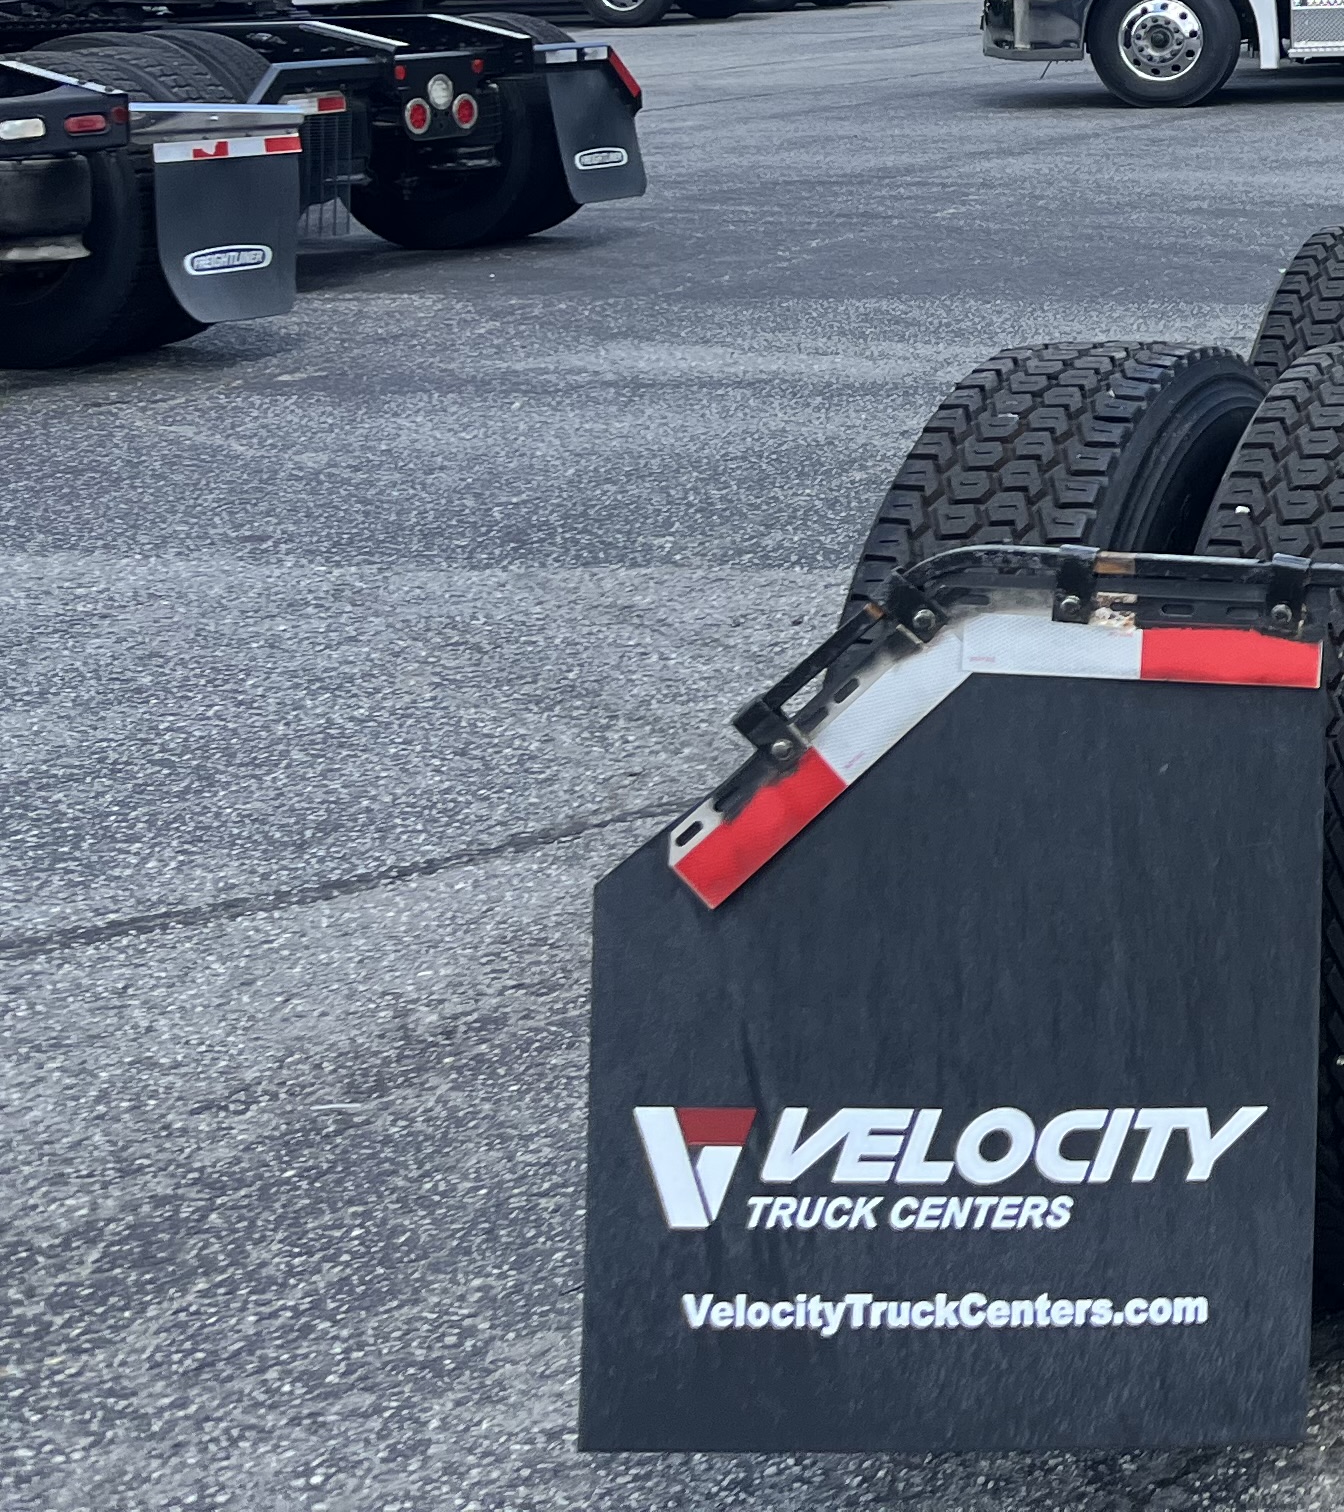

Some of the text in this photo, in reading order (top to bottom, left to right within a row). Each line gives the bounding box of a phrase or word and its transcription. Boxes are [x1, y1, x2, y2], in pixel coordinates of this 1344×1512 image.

[761, 1106, 1268, 1184] VELOCITY
[747, 1196, 1074, 1231] TRUCK CENTERS
[681, 1291, 1208, 1337] VelocityTruckCenters.com
